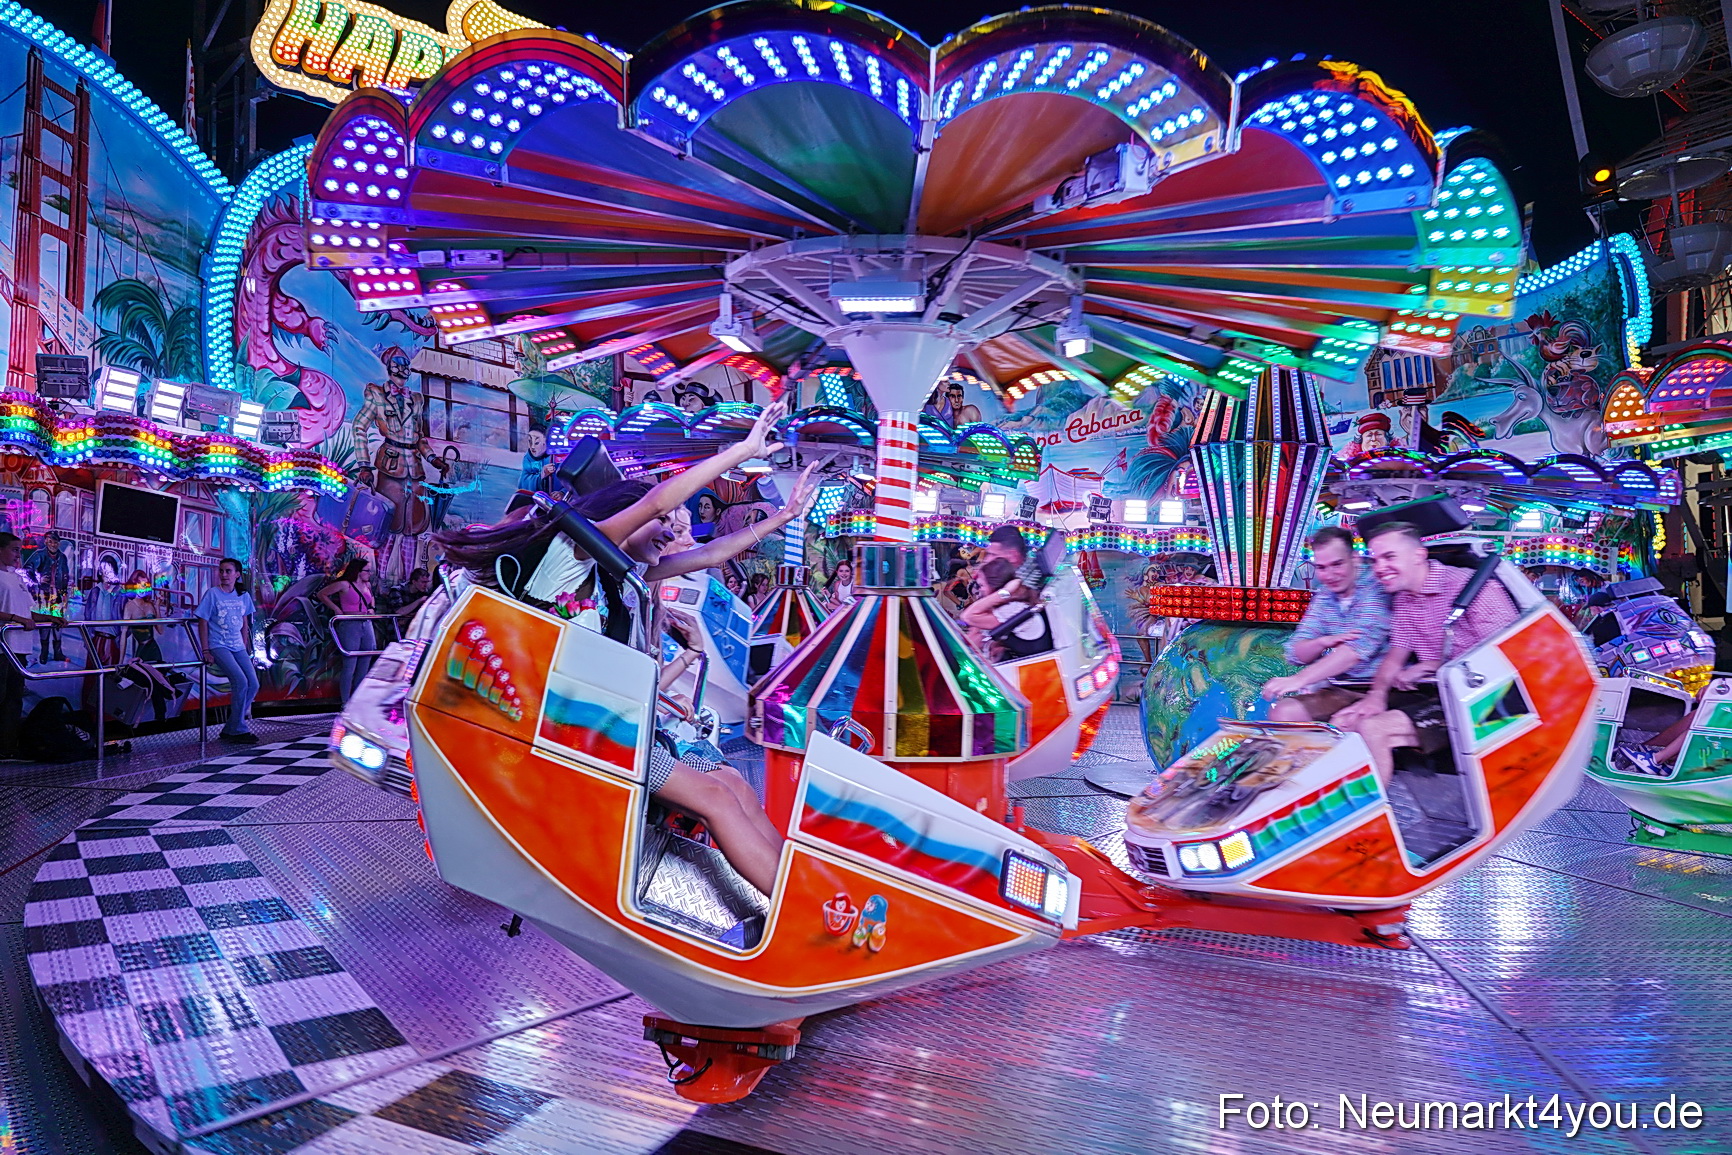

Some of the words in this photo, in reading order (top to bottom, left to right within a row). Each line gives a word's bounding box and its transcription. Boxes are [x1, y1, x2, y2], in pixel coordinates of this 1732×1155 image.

[271, 0, 462, 89] HAP
[1021, 432, 1062, 448] pa
[1065, 409, 1143, 443] Cabana
